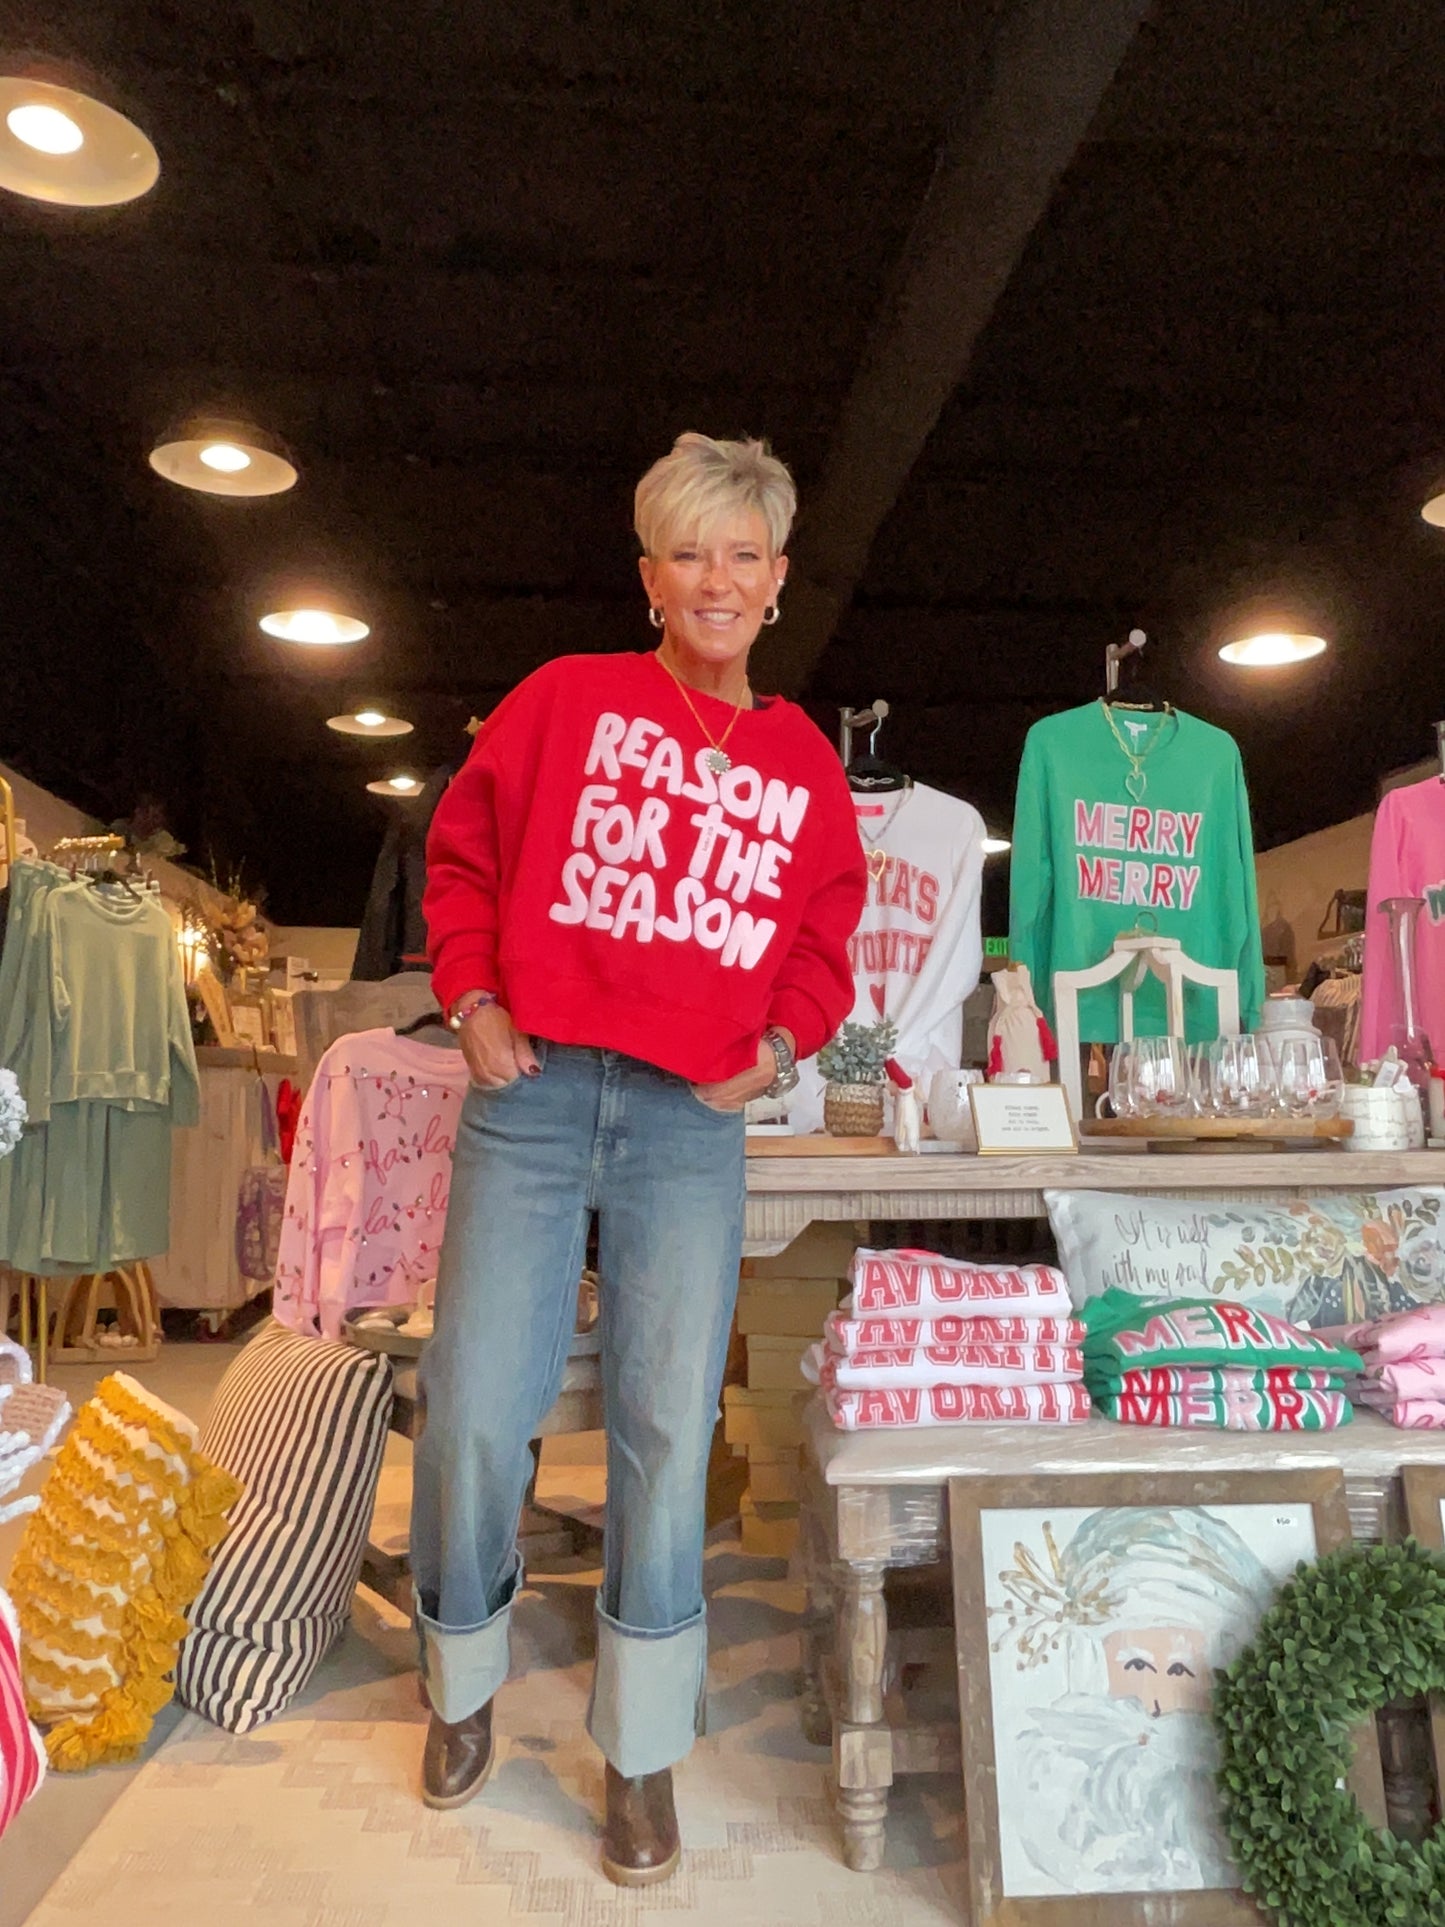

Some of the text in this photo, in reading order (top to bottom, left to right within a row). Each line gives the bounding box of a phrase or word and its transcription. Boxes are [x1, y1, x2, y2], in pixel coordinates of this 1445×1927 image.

[584, 711, 810, 843] REASON
[571, 784, 793, 904] FOR THE
[1074, 798, 1202, 859] MERRY
[549, 851, 777, 970] SEASON
[1076, 853, 1201, 911] MERRY
[985, 937, 1009, 956] EXIT
[1176, 1212, 1211, 1249] well
[1101, 1246, 1213, 1297] with my soul
